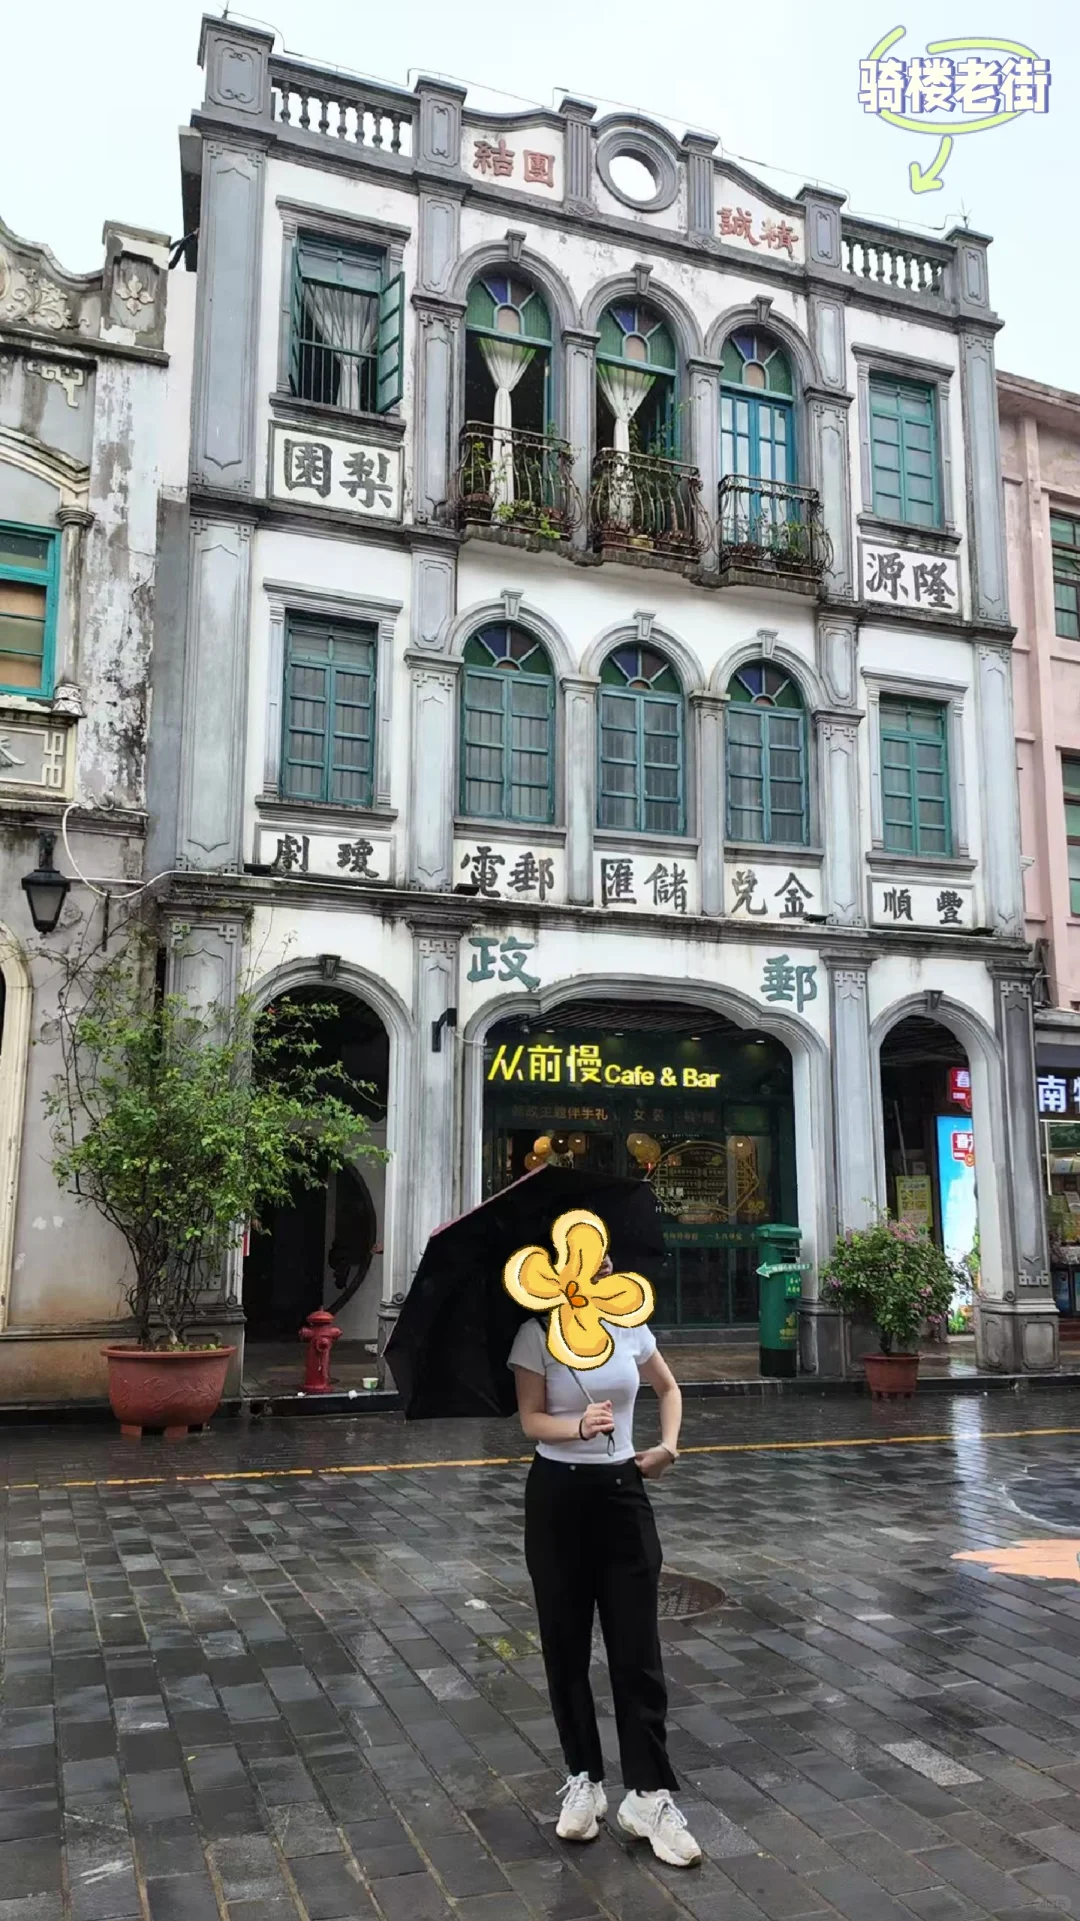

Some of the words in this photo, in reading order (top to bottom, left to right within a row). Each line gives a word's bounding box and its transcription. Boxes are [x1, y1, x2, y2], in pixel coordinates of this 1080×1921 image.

[488, 1045, 602, 1083] 从前慢
[605, 1065, 655, 1087] Cafe
[660, 1069, 678, 1087] &
[683, 1068, 721, 1088] Bar
